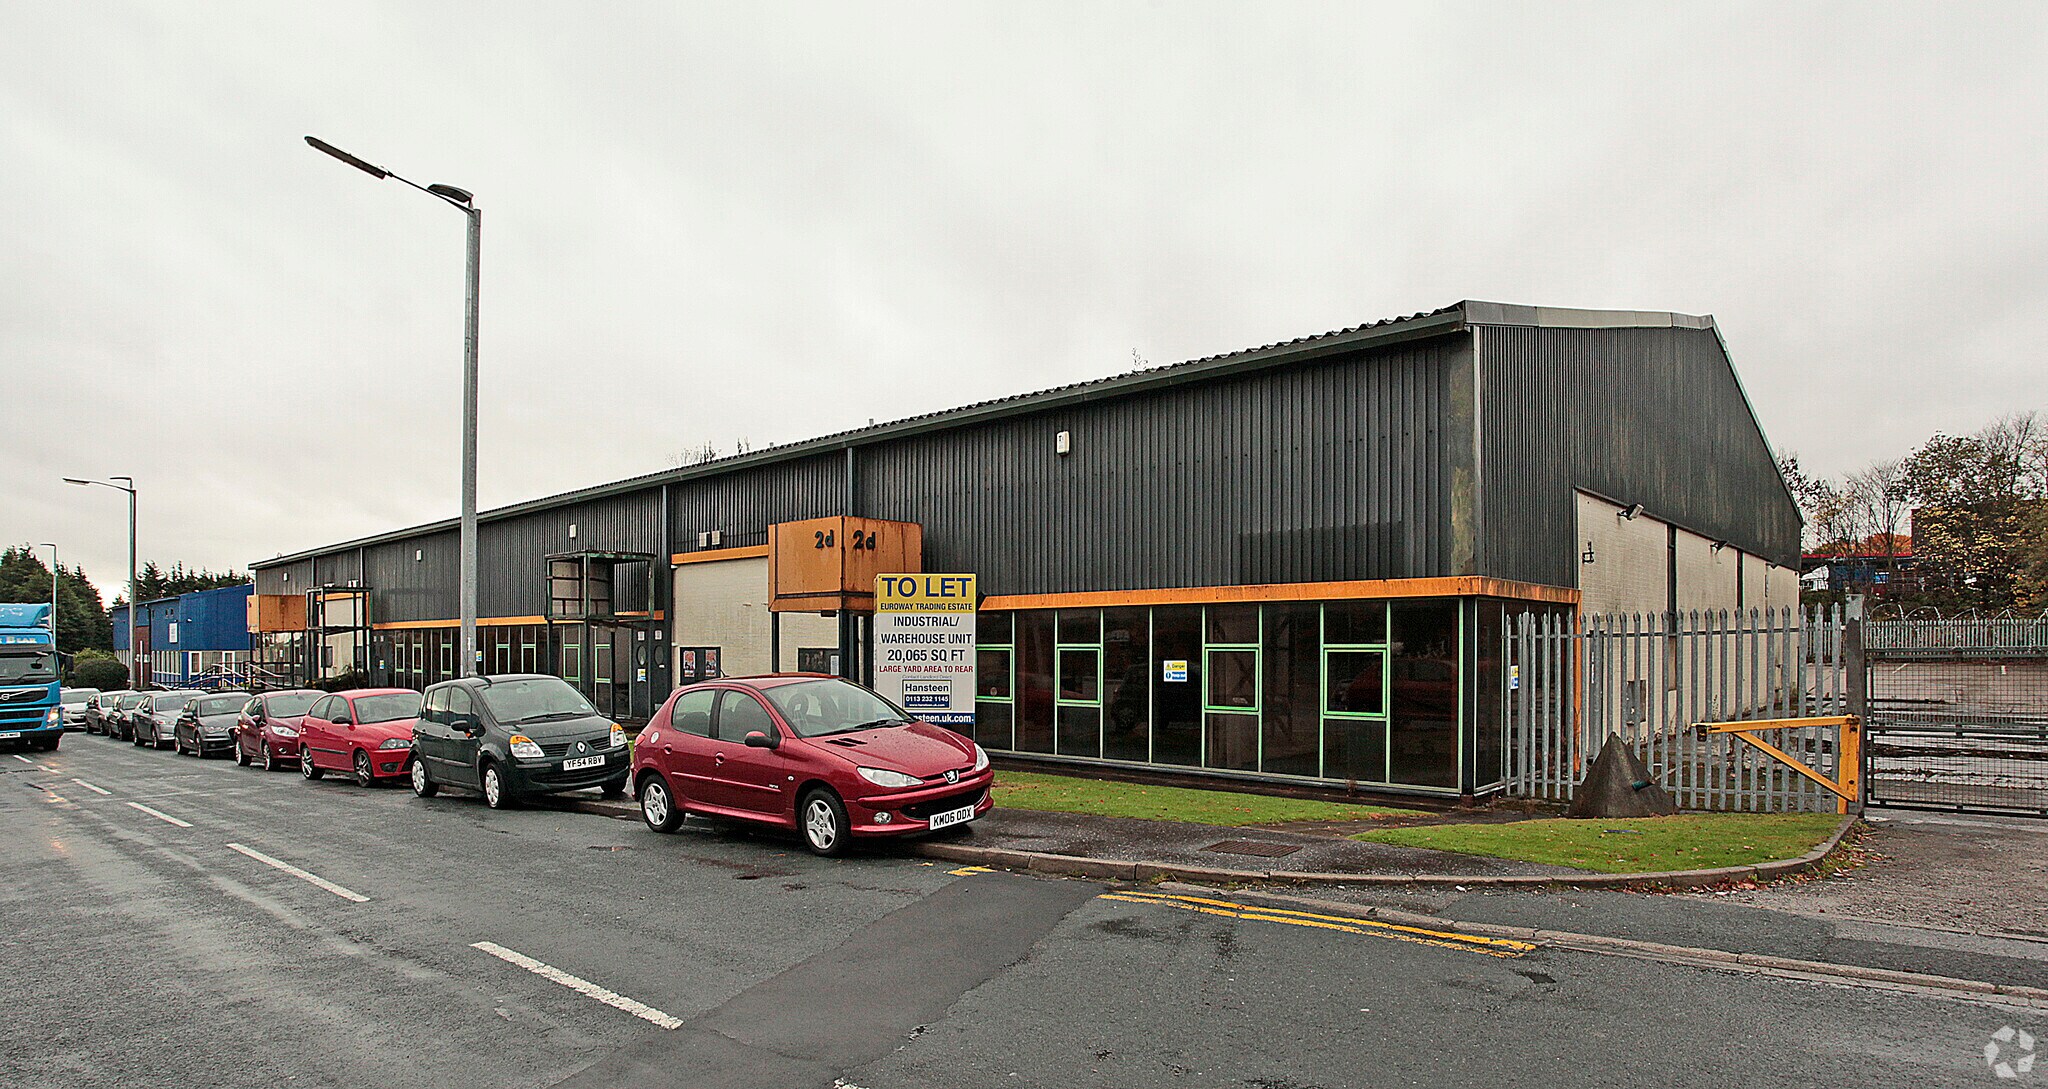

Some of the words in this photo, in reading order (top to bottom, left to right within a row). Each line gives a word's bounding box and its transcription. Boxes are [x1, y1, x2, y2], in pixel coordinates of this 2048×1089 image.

[815, 529, 834, 548] 2d
[853, 530, 876, 550] 2d
[881, 577, 917, 597] TO
[925, 577, 972, 597] LET
[880, 602, 914, 611] EUROWAY
[915, 602, 946, 611] TRADING
[947, 602, 973, 611] ESTATE
[893, 616, 960, 627] INDUSTRIAL/
[881, 633, 945, 645] WAREHOUSE
[948, 633, 972, 644] UNIT
[887, 649, 928, 663] 20,065
[930, 649, 948, 662] SQ
[951, 649, 966, 661] FT
[879, 665, 902, 673] LARGE
[903, 665, 922, 673] YARD
[923, 665, 942, 673] AREA
[944, 665, 953, 673] TO
[954, 665, 974, 673] REAR
[905, 683, 949, 692] Hansteen
[567, 758, 586, 768] YF54
[934, 812, 955, 826] KM06
[957, 807, 971, 820] ODX
